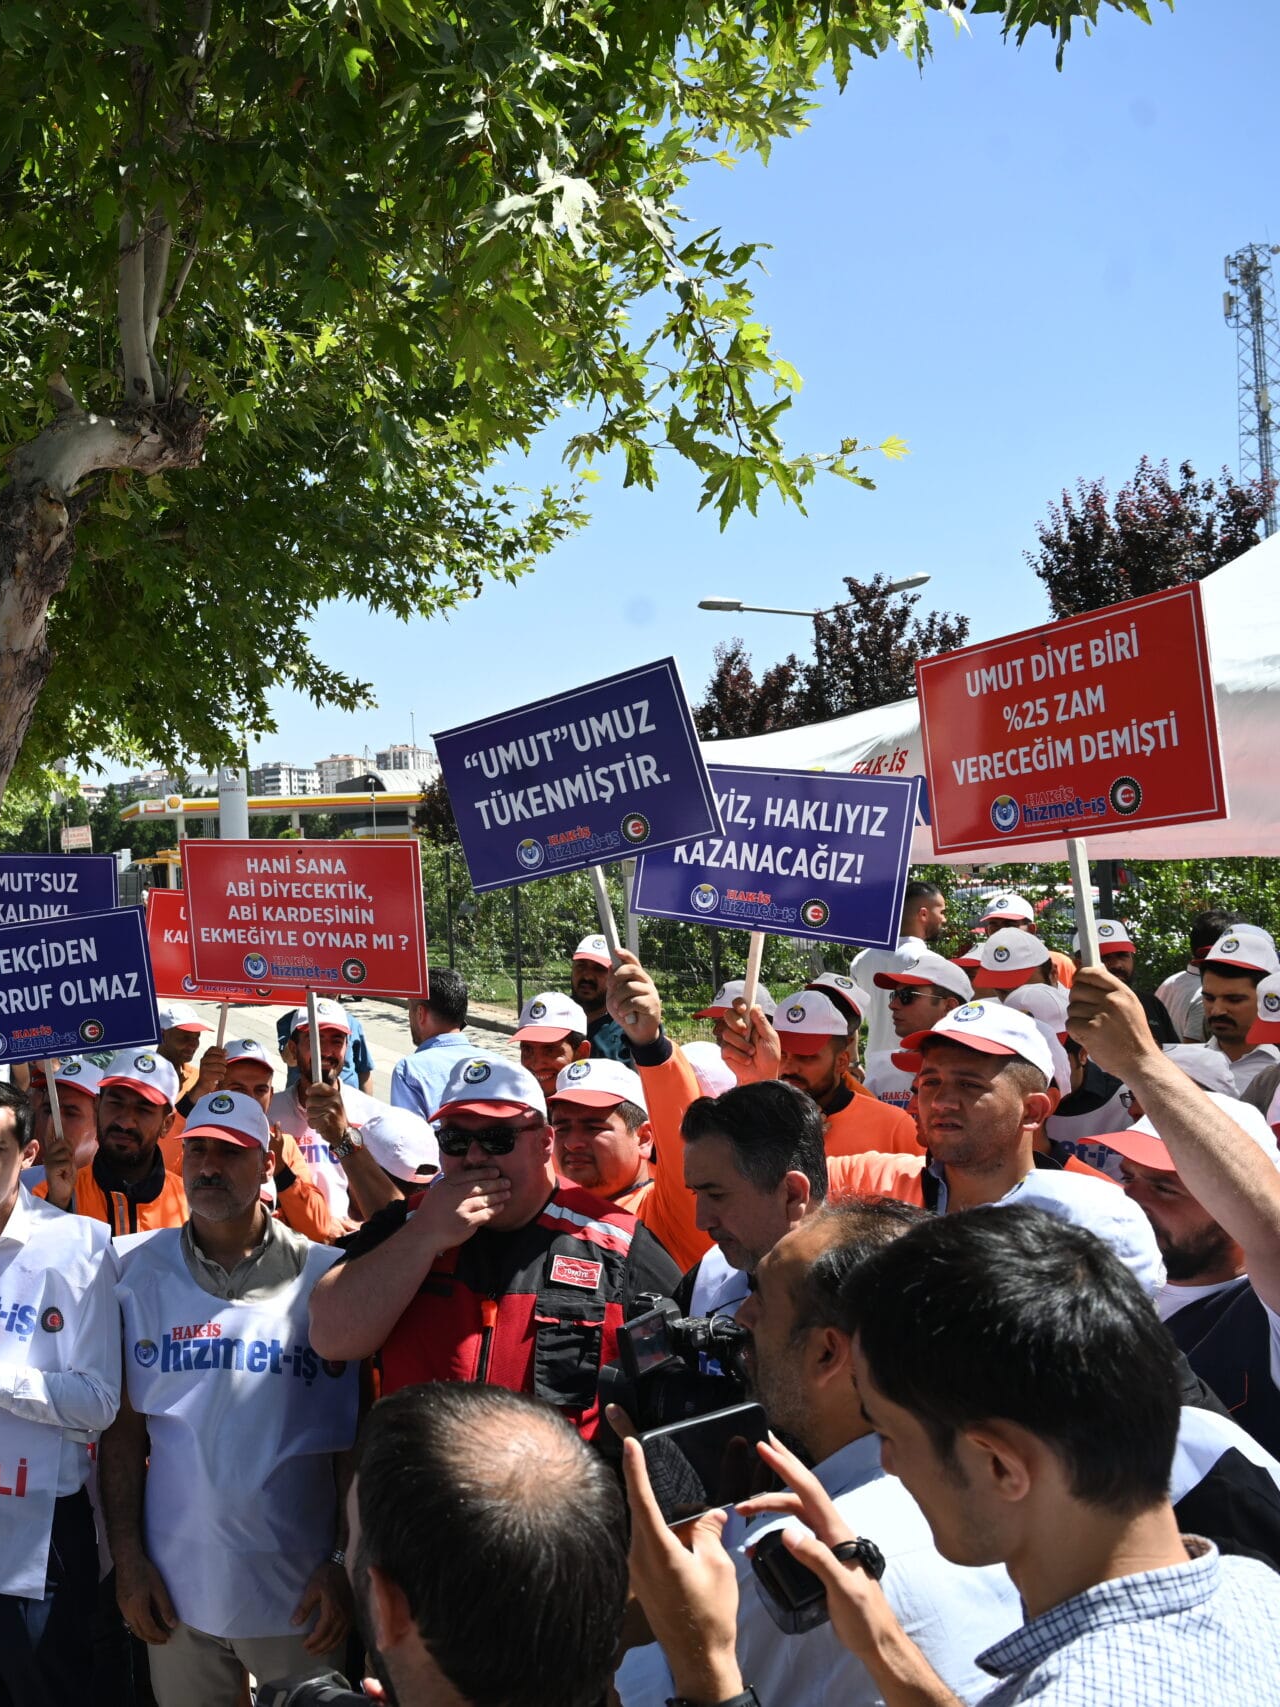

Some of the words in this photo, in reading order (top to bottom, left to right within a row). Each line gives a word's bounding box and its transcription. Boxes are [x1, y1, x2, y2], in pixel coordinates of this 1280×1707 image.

[965, 658, 1025, 698] UMUT
[1032, 645, 1085, 682] DİYE
[1090, 622, 1139, 668] BİRİ
[1003, 700, 1049, 732] %25
[1053, 685, 1105, 724] ZAM
[952, 735, 1074, 786] VERECEĞİM
[1080, 711, 1178, 763] DEMİŞTİ
[475, 753, 670, 830] TÜKENMİŞTİR.
[718, 788, 755, 830] YİZ,
[764, 798, 888, 837] HAKLIYIZ
[1023, 797, 1106, 822] hizmet-iş
[545, 831, 620, 860] hizmet-iş
[247, 855, 290, 874] HANİ
[296, 858, 347, 875] SANA
[674, 843, 863, 885] KAZANACAĞIZ!
[226, 880, 255, 897] ABİ
[261, 880, 373, 902] DİYECEKTİK,
[228, 903, 258, 921] ABİ
[263, 905, 375, 926] KARDEŞİNİN
[720, 896, 797, 922] hizmet-iş
[200, 926, 298, 947] EKMEĞİYLE
[302, 931, 367, 949] OYNAR
[373, 933, 394, 949] MI
[400, 934, 409, 951] ?
[57, 972, 141, 1006] OLMAZ
[172, 1320, 221, 1340] HAK-İŞ
[162, 1335, 318, 1386] hizmet-iş
